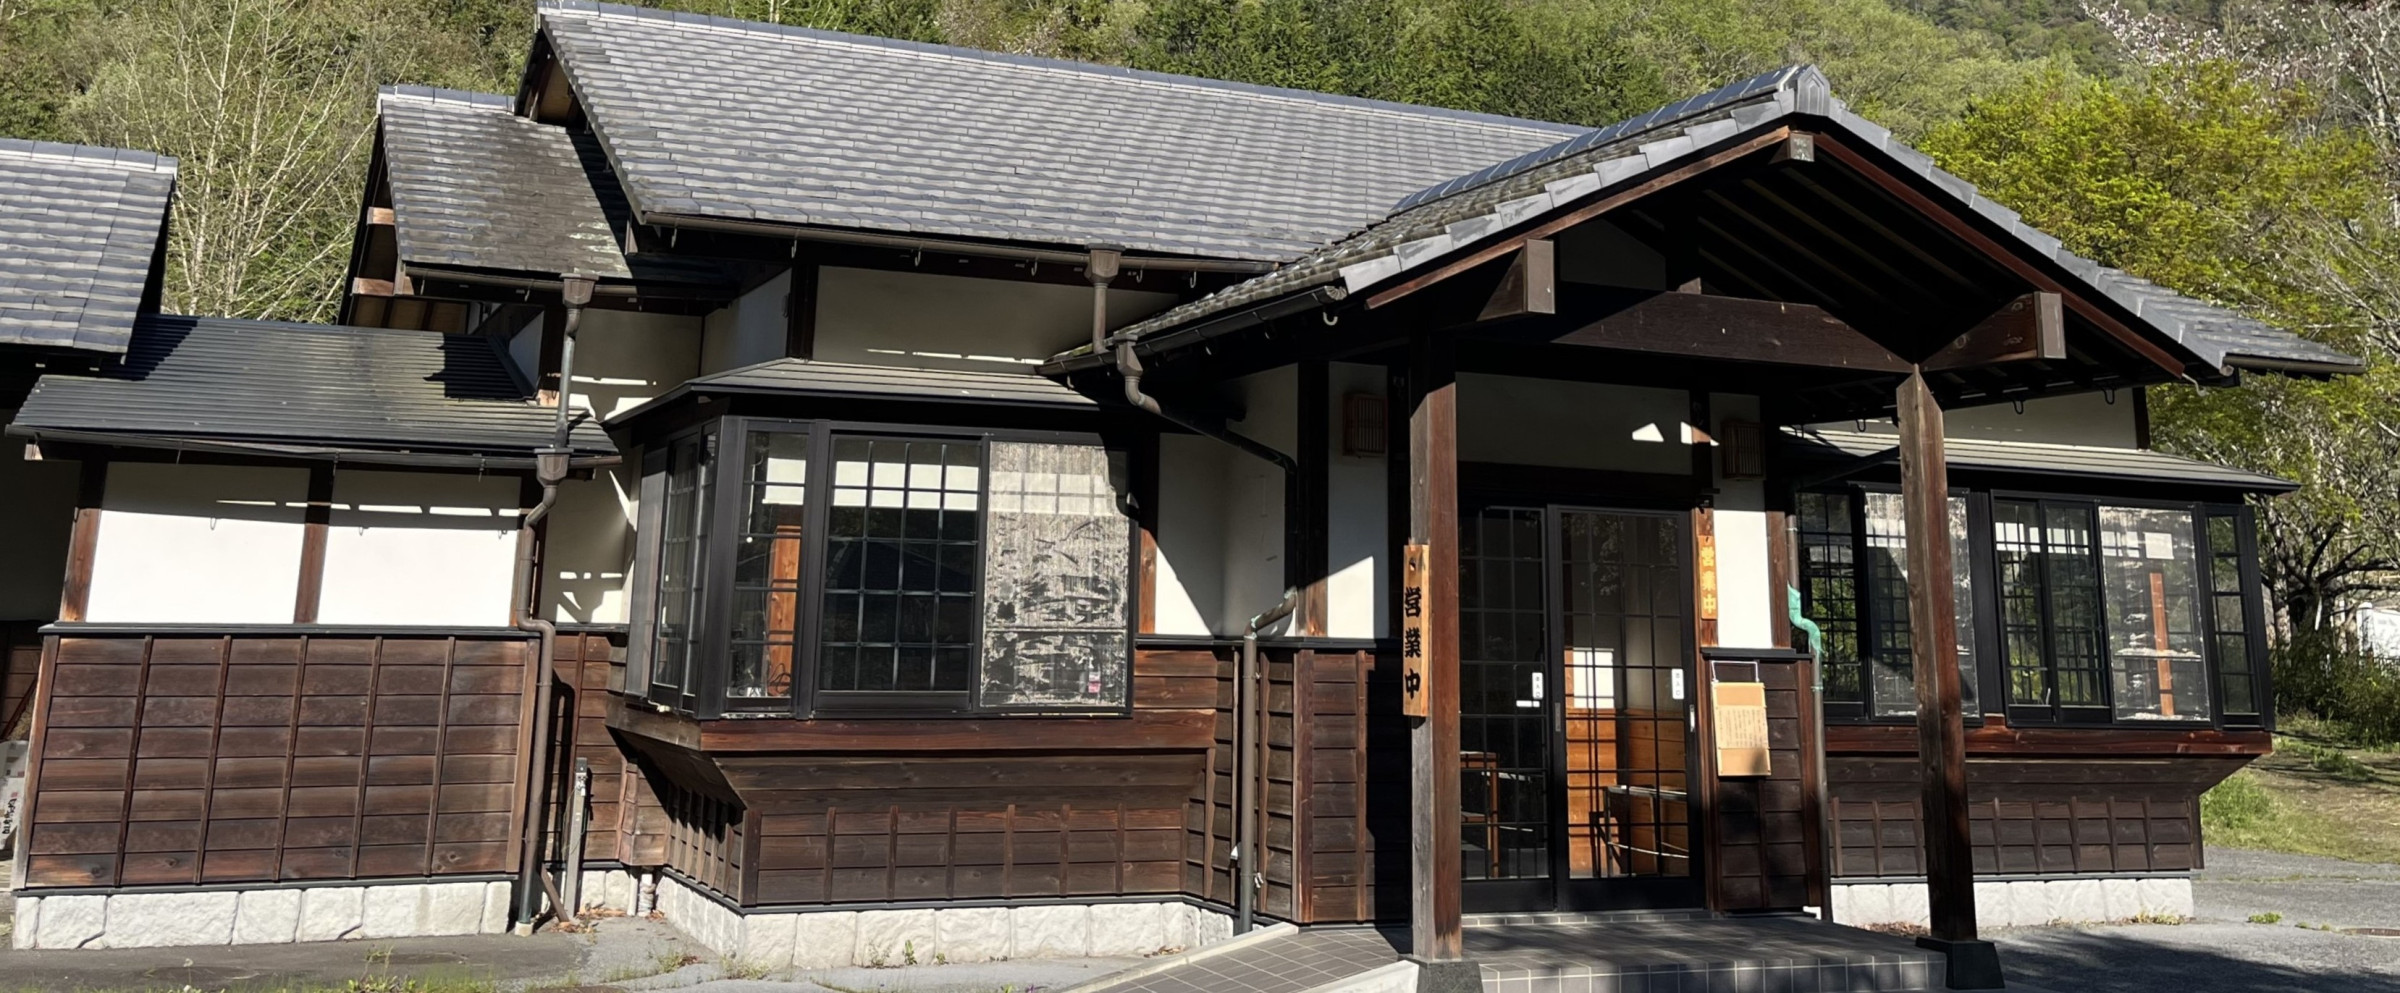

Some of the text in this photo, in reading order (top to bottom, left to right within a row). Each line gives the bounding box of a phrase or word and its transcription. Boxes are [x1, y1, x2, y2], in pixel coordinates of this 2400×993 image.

[1700, 545, 1717, 615] 営業中
[1404, 586, 1422, 700] 営業中
